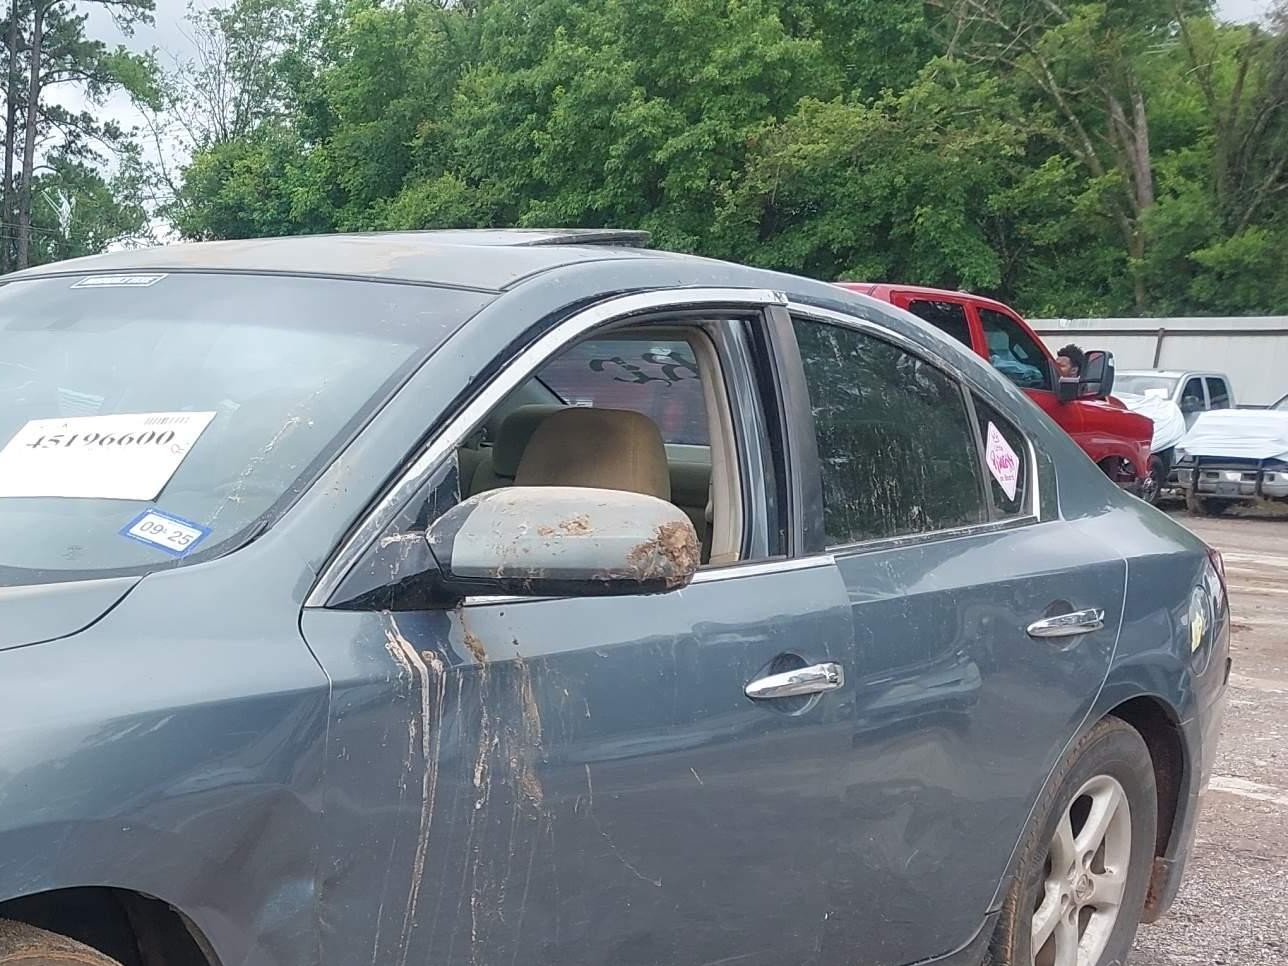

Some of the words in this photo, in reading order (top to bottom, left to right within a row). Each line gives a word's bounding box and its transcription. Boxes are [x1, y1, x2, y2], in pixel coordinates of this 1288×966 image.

[25, 430, 176, 449] 45196600
[139, 521, 164, 535] 09
[167, 530, 194, 546] 25
